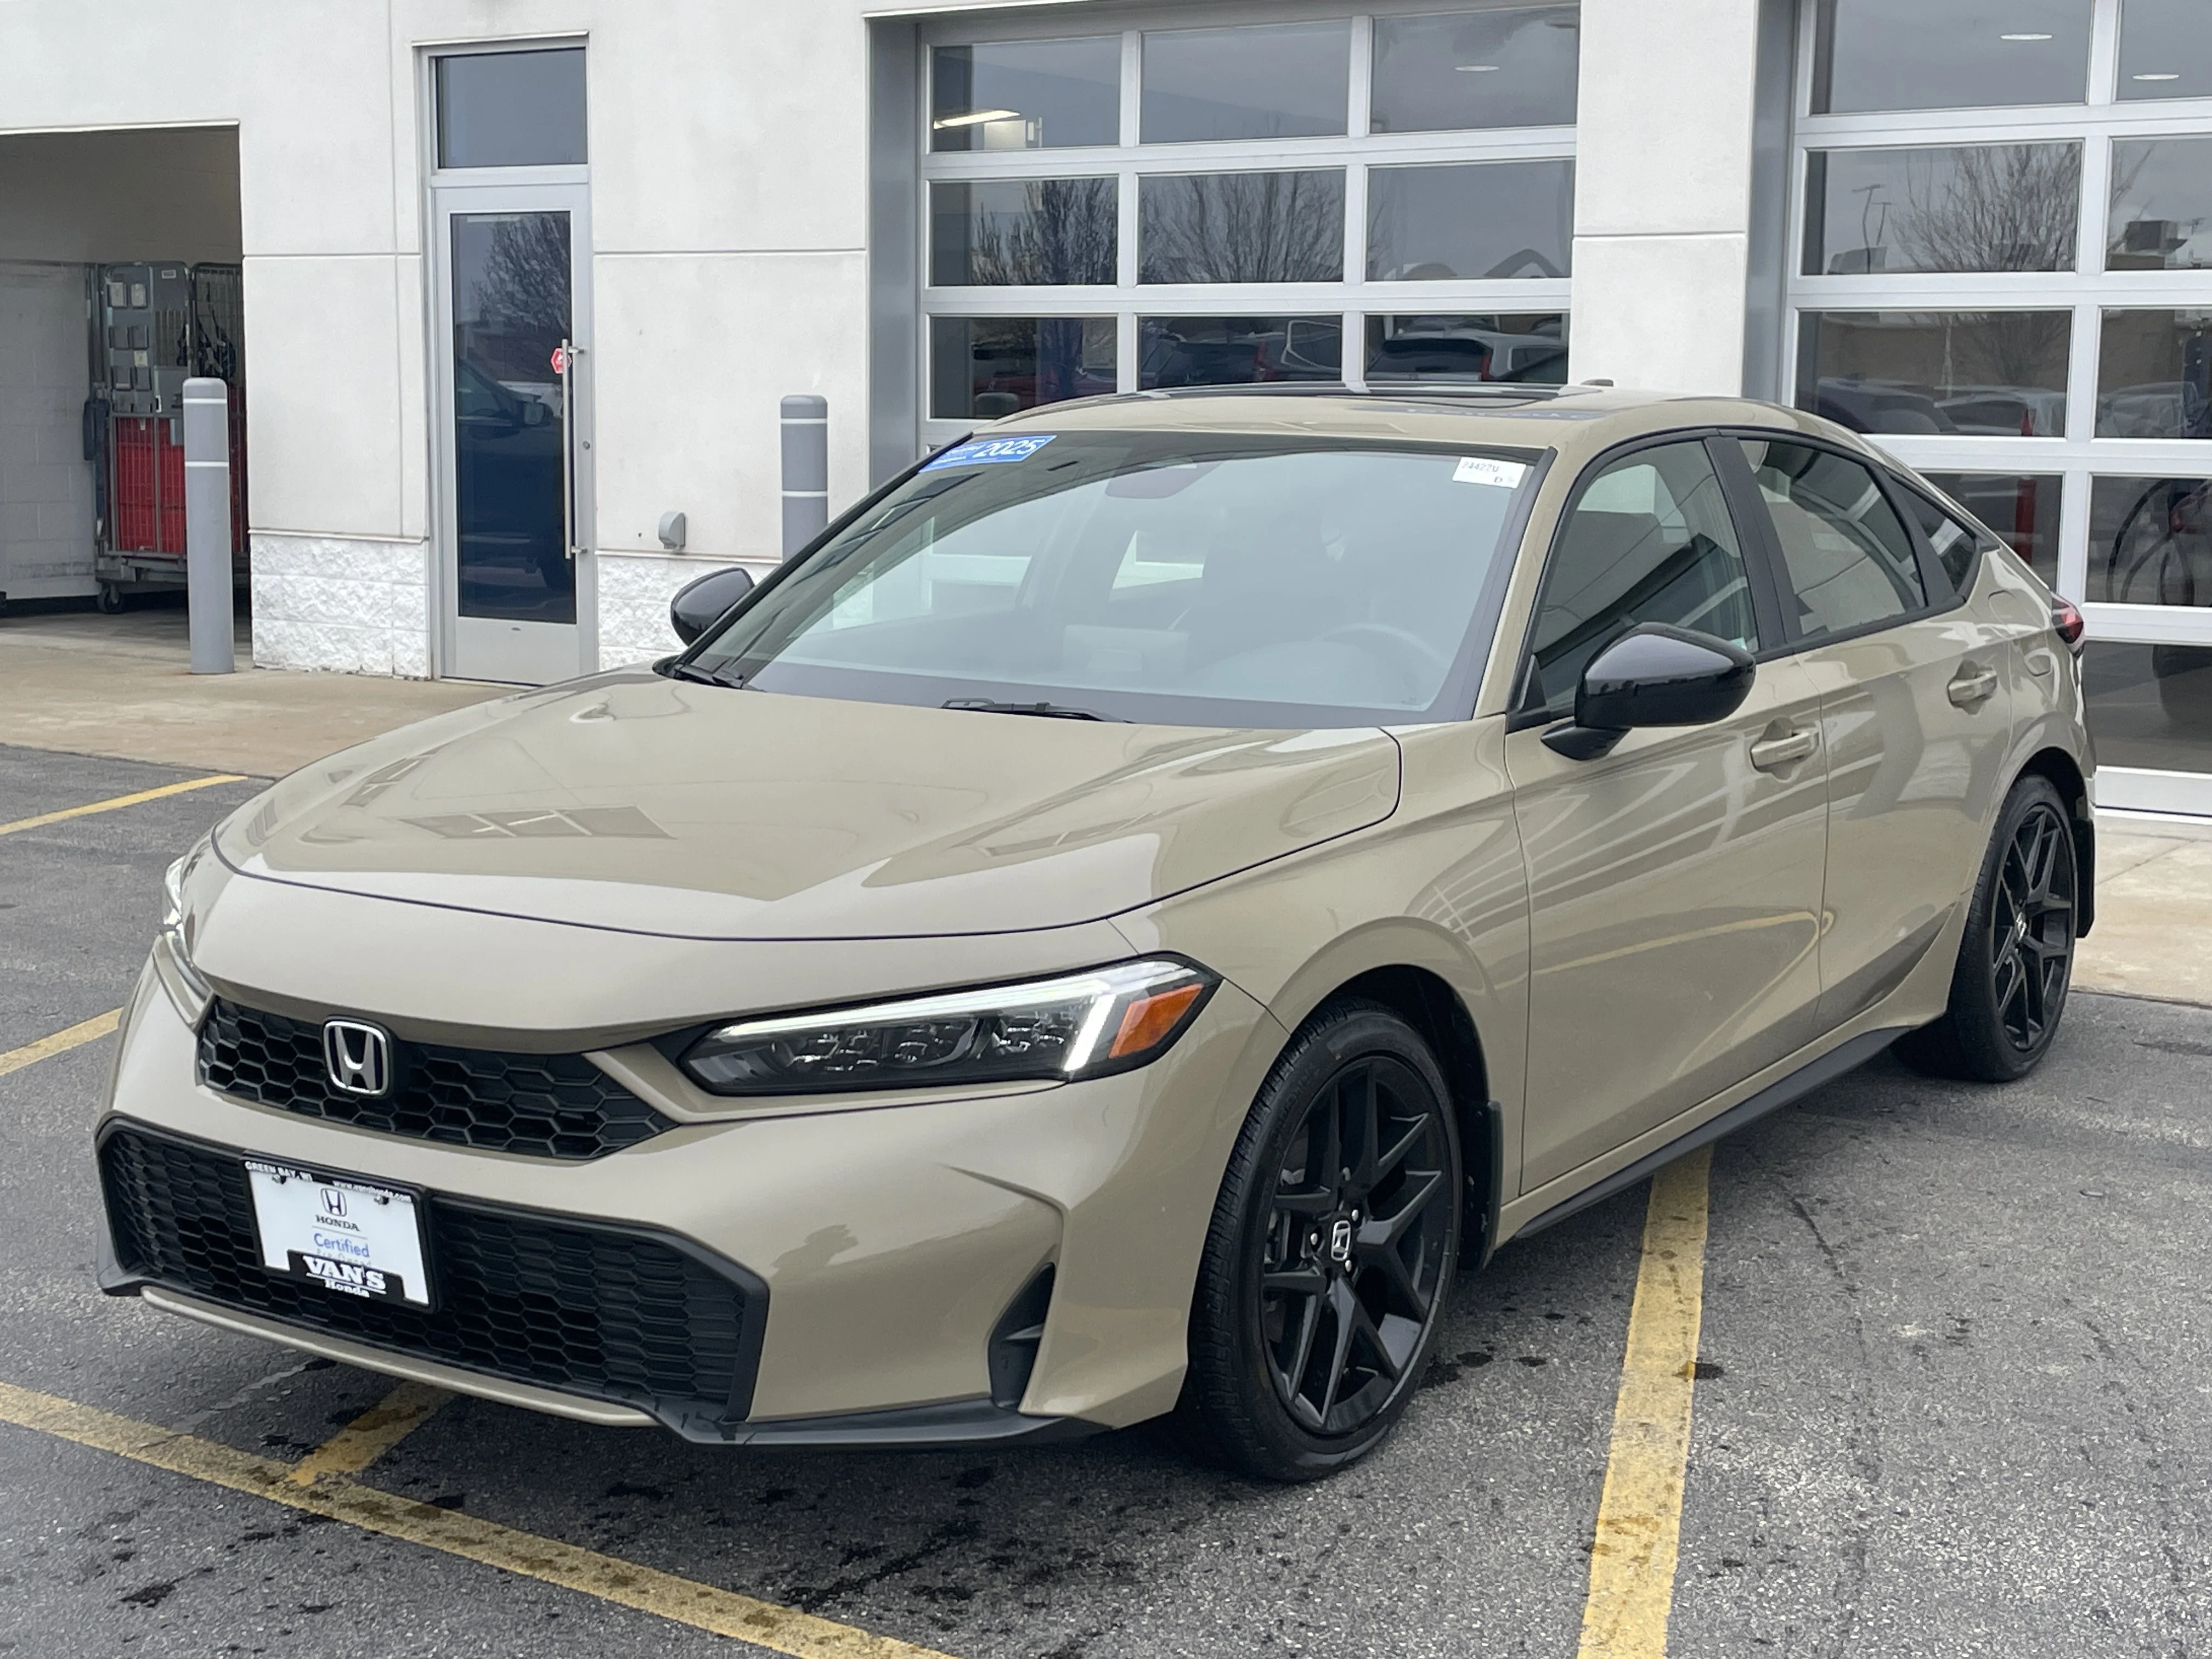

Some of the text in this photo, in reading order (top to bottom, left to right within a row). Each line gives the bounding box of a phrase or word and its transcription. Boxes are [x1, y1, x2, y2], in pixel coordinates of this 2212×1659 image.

[972, 439, 1045, 458] 2025
[315, 1214, 361, 1232] HONDA
[314, 1233, 370, 1257] Certified
[325, 1278, 371, 1298] Honda
